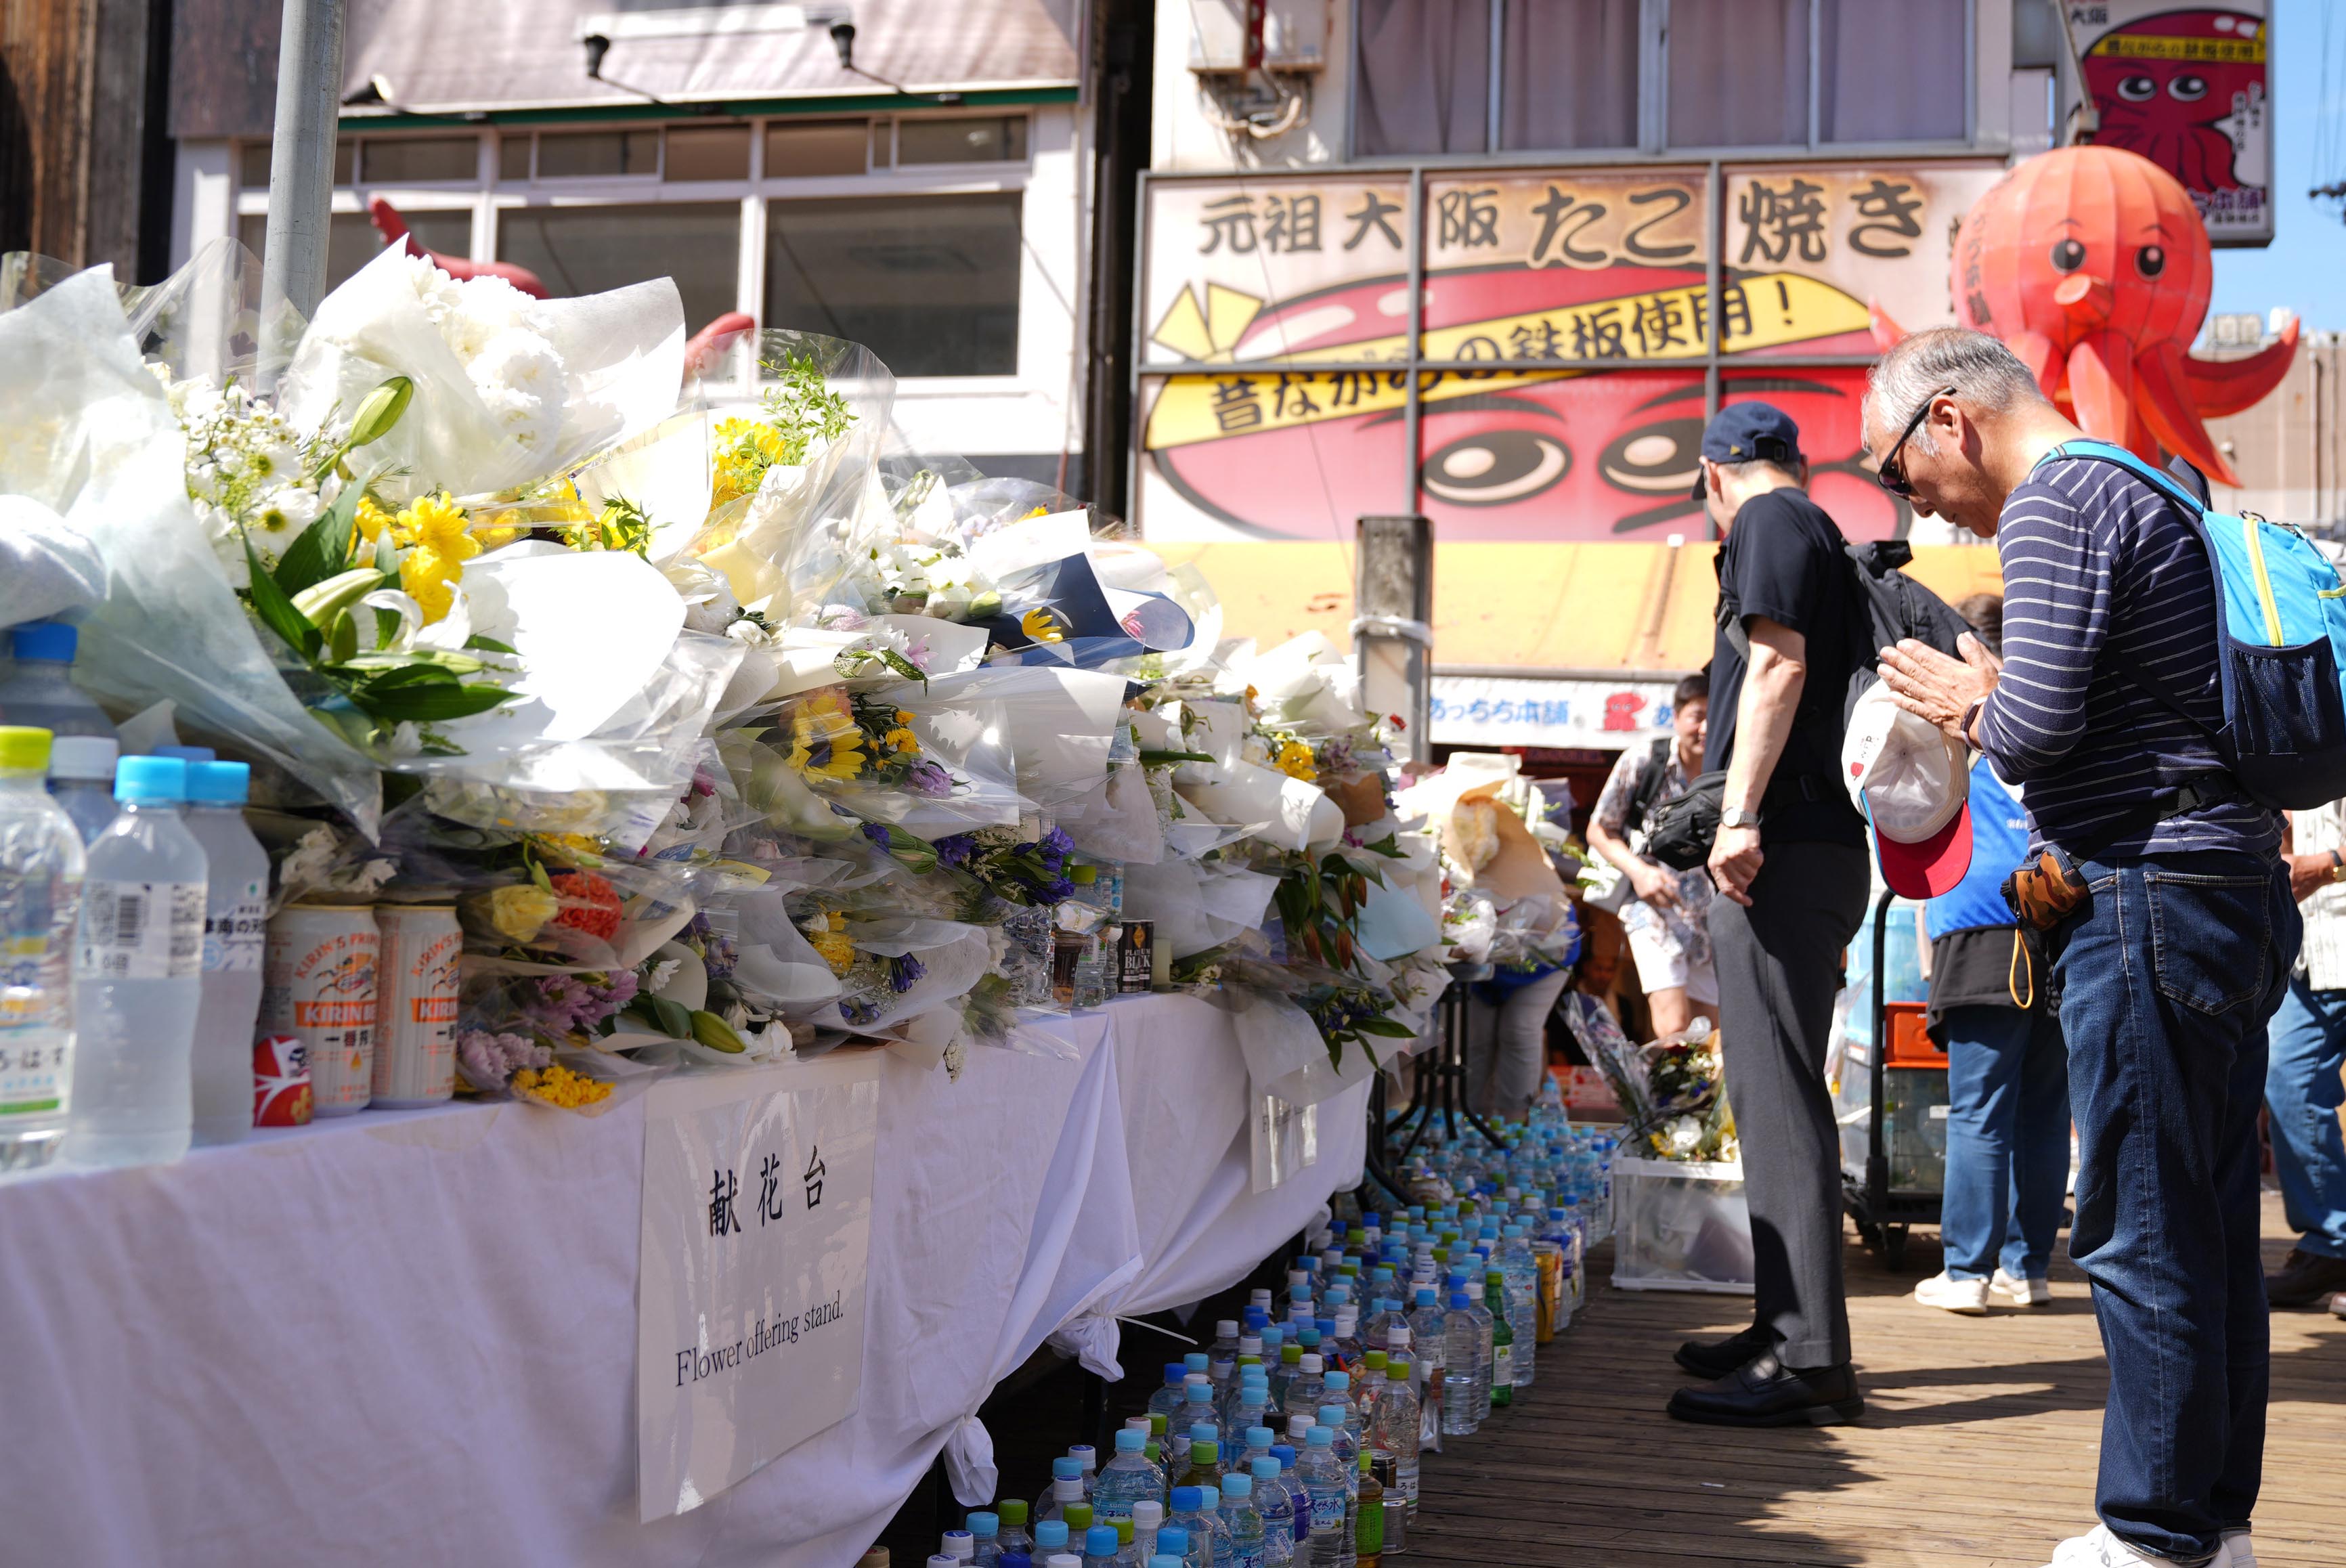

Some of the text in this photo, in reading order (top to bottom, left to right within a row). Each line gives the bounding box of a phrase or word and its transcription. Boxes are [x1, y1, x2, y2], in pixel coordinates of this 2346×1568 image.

[1198, 179, 1923, 264] 元祖大阪たこ焼き
[305, 1005, 362, 1022] KIRIN
[709, 1145, 826, 1237] 献花台
[676, 1290, 844, 1387] Flower offering stand.
